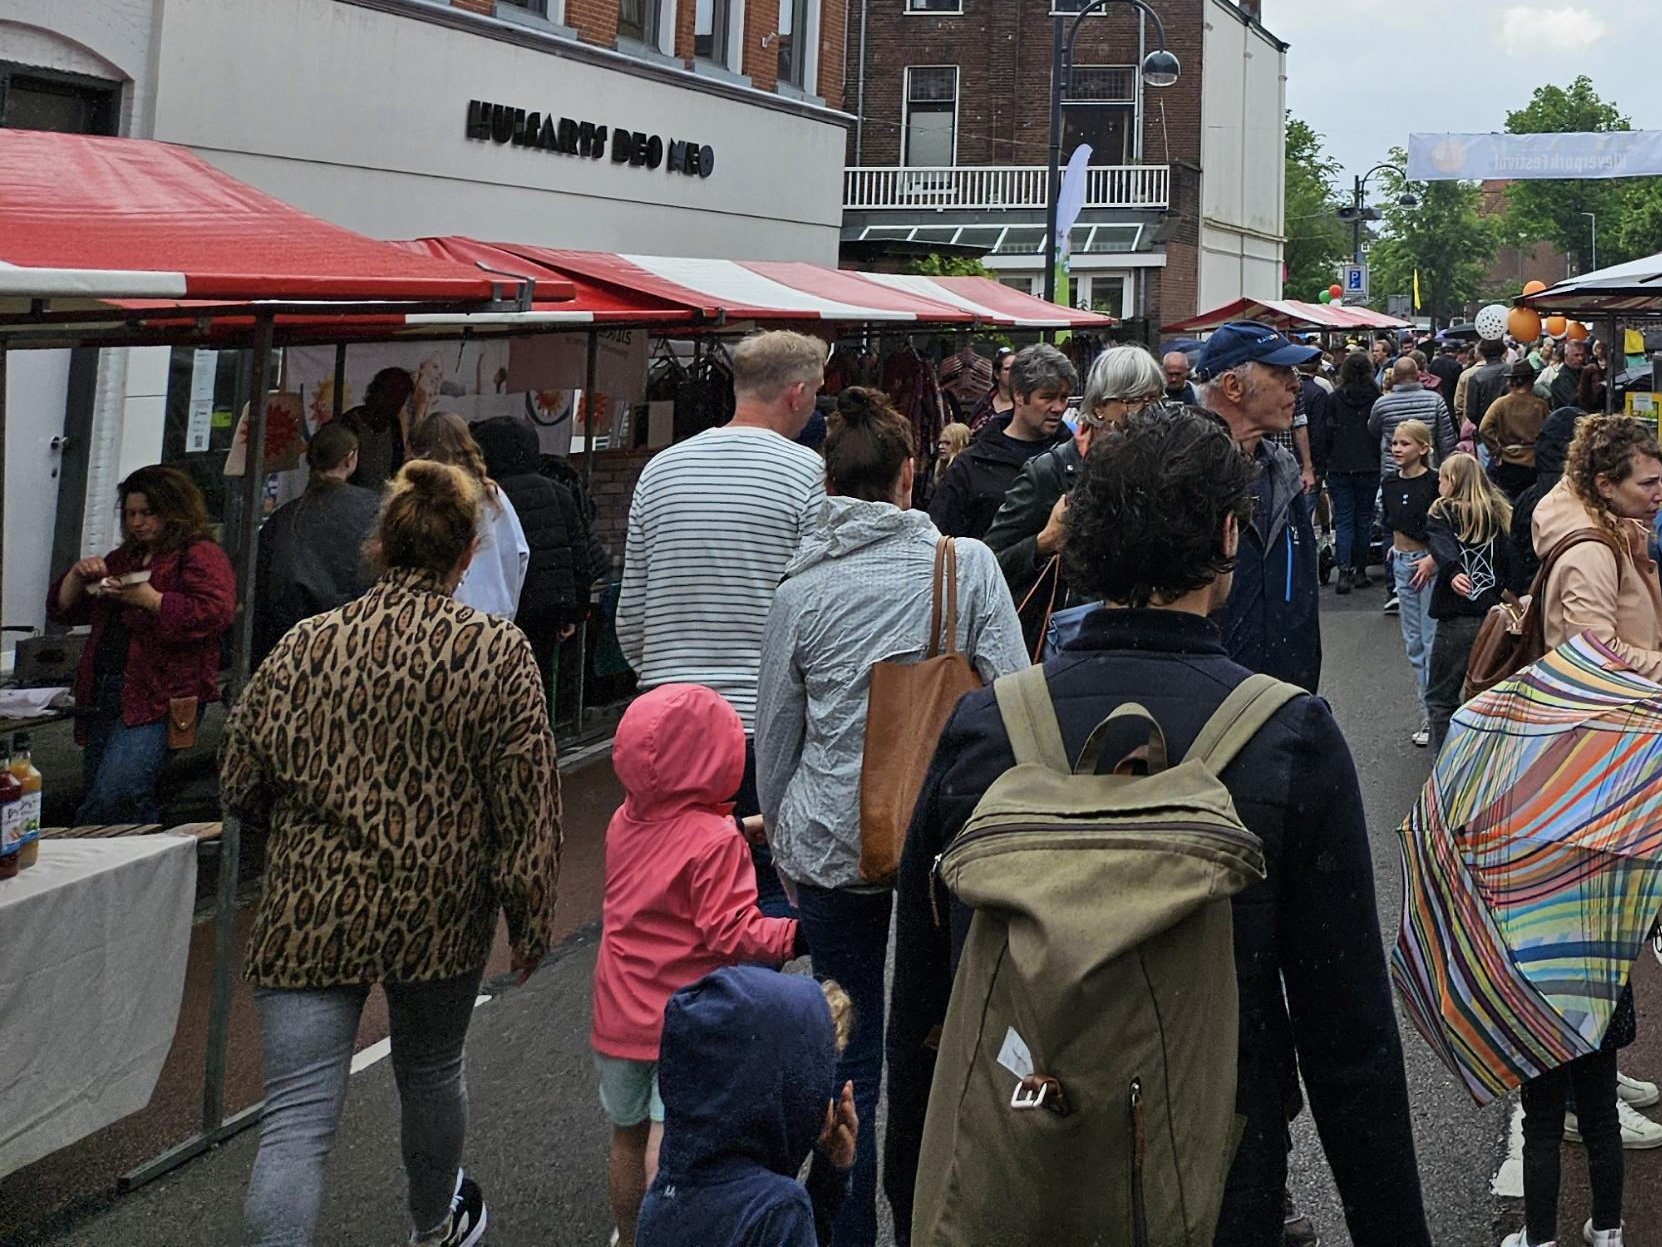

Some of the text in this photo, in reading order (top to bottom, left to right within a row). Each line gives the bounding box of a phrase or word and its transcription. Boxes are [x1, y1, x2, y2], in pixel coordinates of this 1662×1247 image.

[466, 99, 715, 179] HUISARTS DEO NEO
